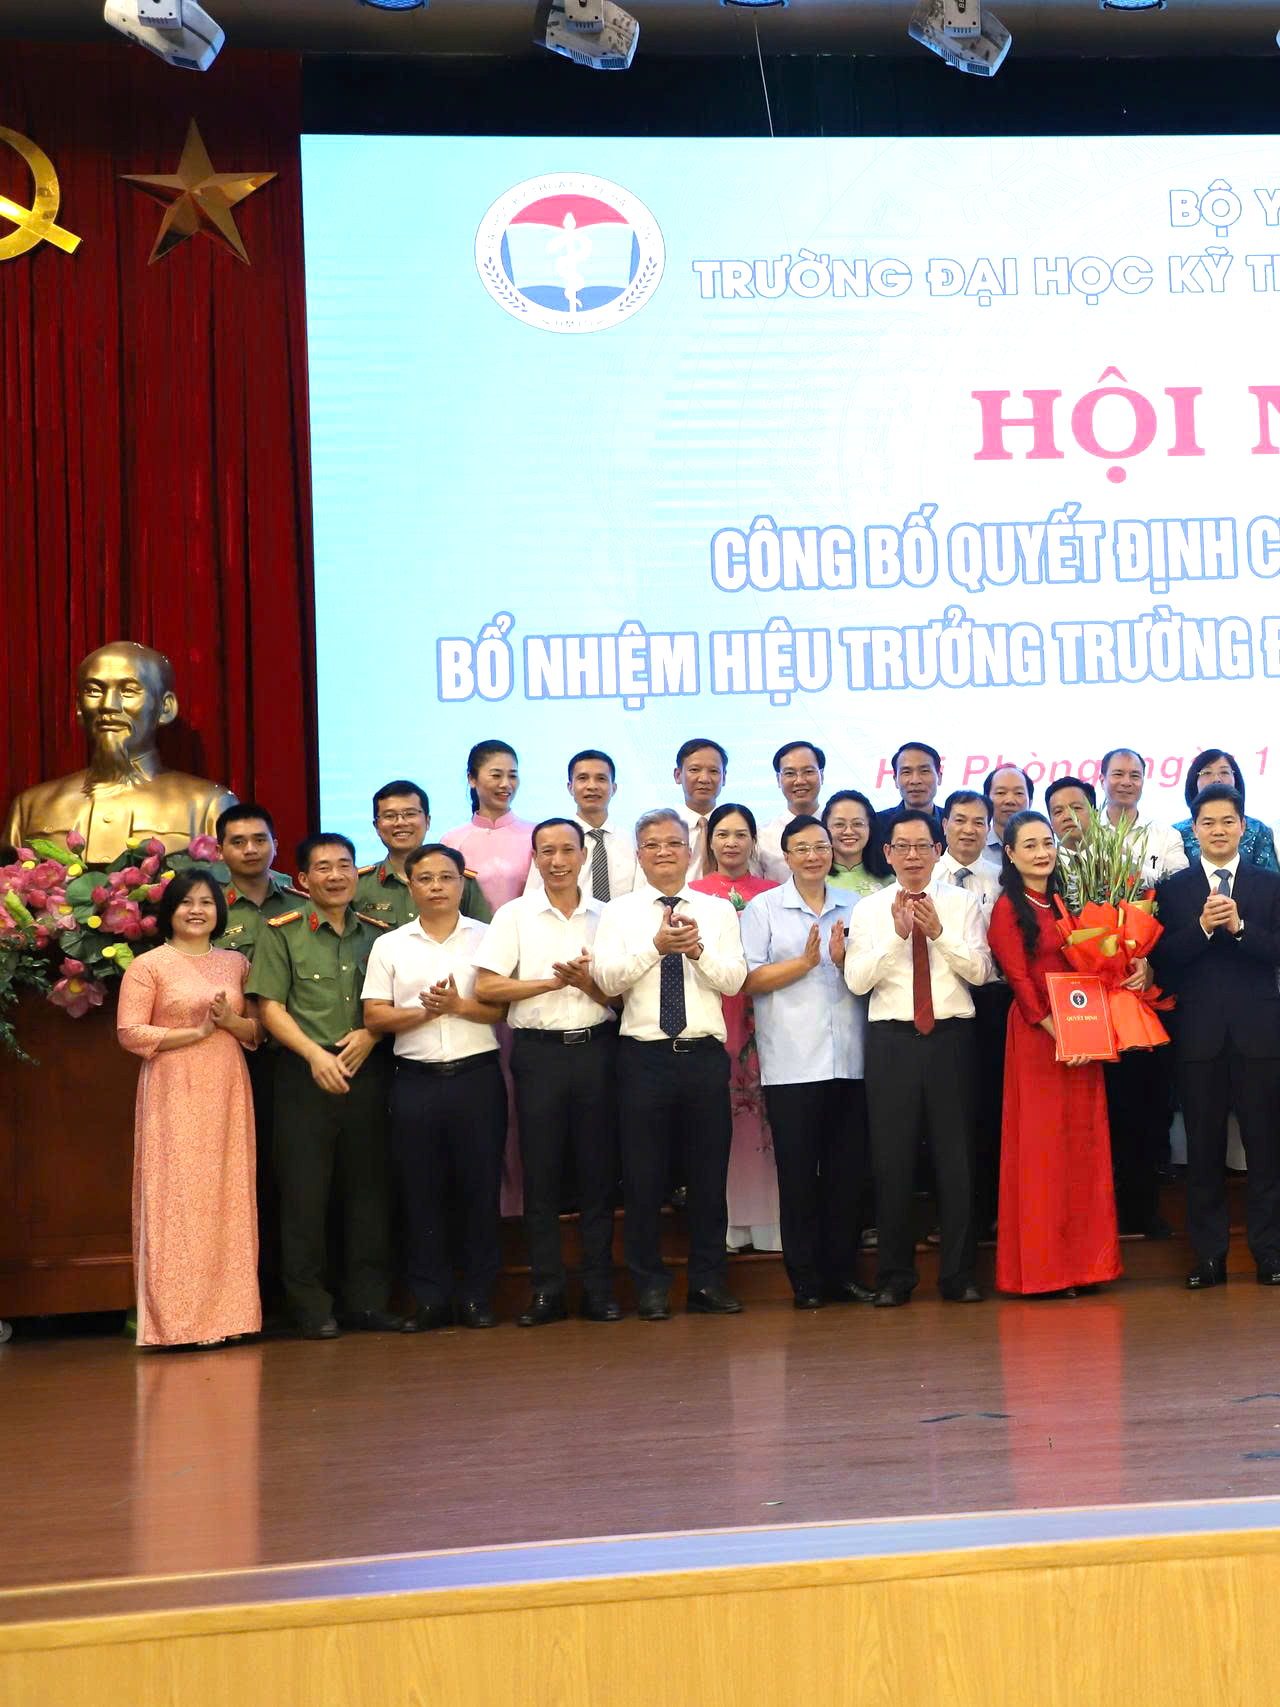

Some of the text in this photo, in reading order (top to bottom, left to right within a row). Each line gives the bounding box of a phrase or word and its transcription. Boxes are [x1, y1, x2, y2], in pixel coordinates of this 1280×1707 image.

[1169, 179, 1242, 237] BỘ
[692, 248, 912, 298] TRƯỜNG
[926, 258, 1018, 307] ĐẠI
[1034, 256, 1153, 305] HỌC
[1168, 246, 1233, 293] KỸ
[972, 366, 1205, 483] HỘI
[710, 515, 856, 593] CÔNG
[864, 503, 938, 588] BỐ
[947, 502, 1106, 593] QUYẾT
[1113, 517, 1238, 594] ĐỊNH
[436, 611, 515, 702] BỔ
[523, 620, 700, 711] NHIỆM
[709, 616, 832, 706] HIỆU
[839, 604, 1045, 691] TRƯỞNG
[1051, 605, 1254, 684] TRƯỜNG
